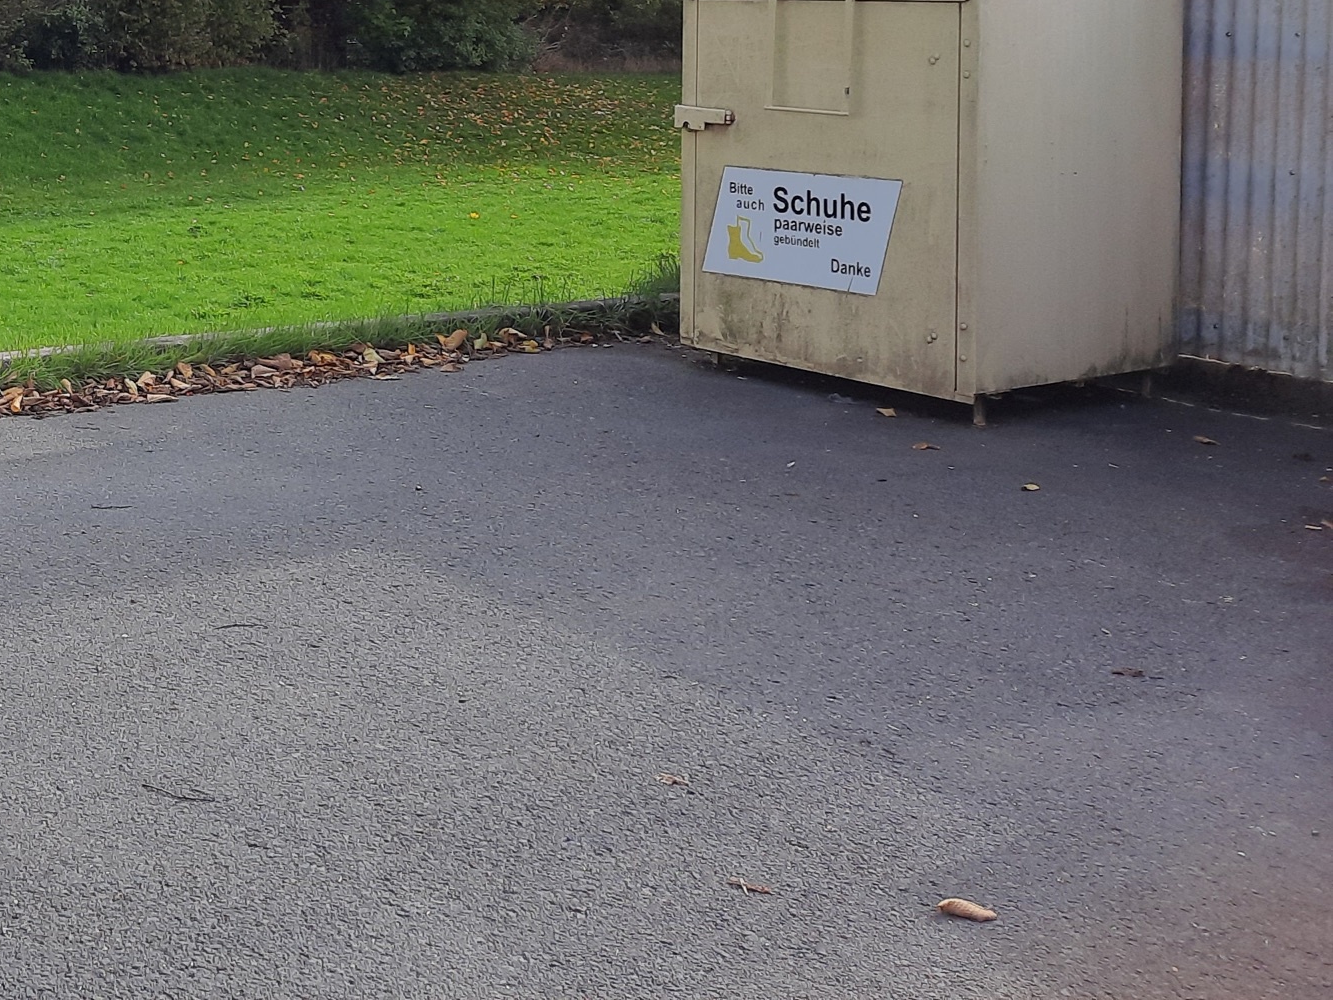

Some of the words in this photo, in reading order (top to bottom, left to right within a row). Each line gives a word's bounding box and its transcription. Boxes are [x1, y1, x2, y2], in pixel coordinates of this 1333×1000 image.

[729, 182, 754, 196] Bitte
[736, 198, 765, 211] auch
[772, 186, 871, 222] Schuhe
[774, 218, 842, 237] paarweise
[773, 234, 820, 249] gebündelt
[831, 258, 871, 278] Danke
